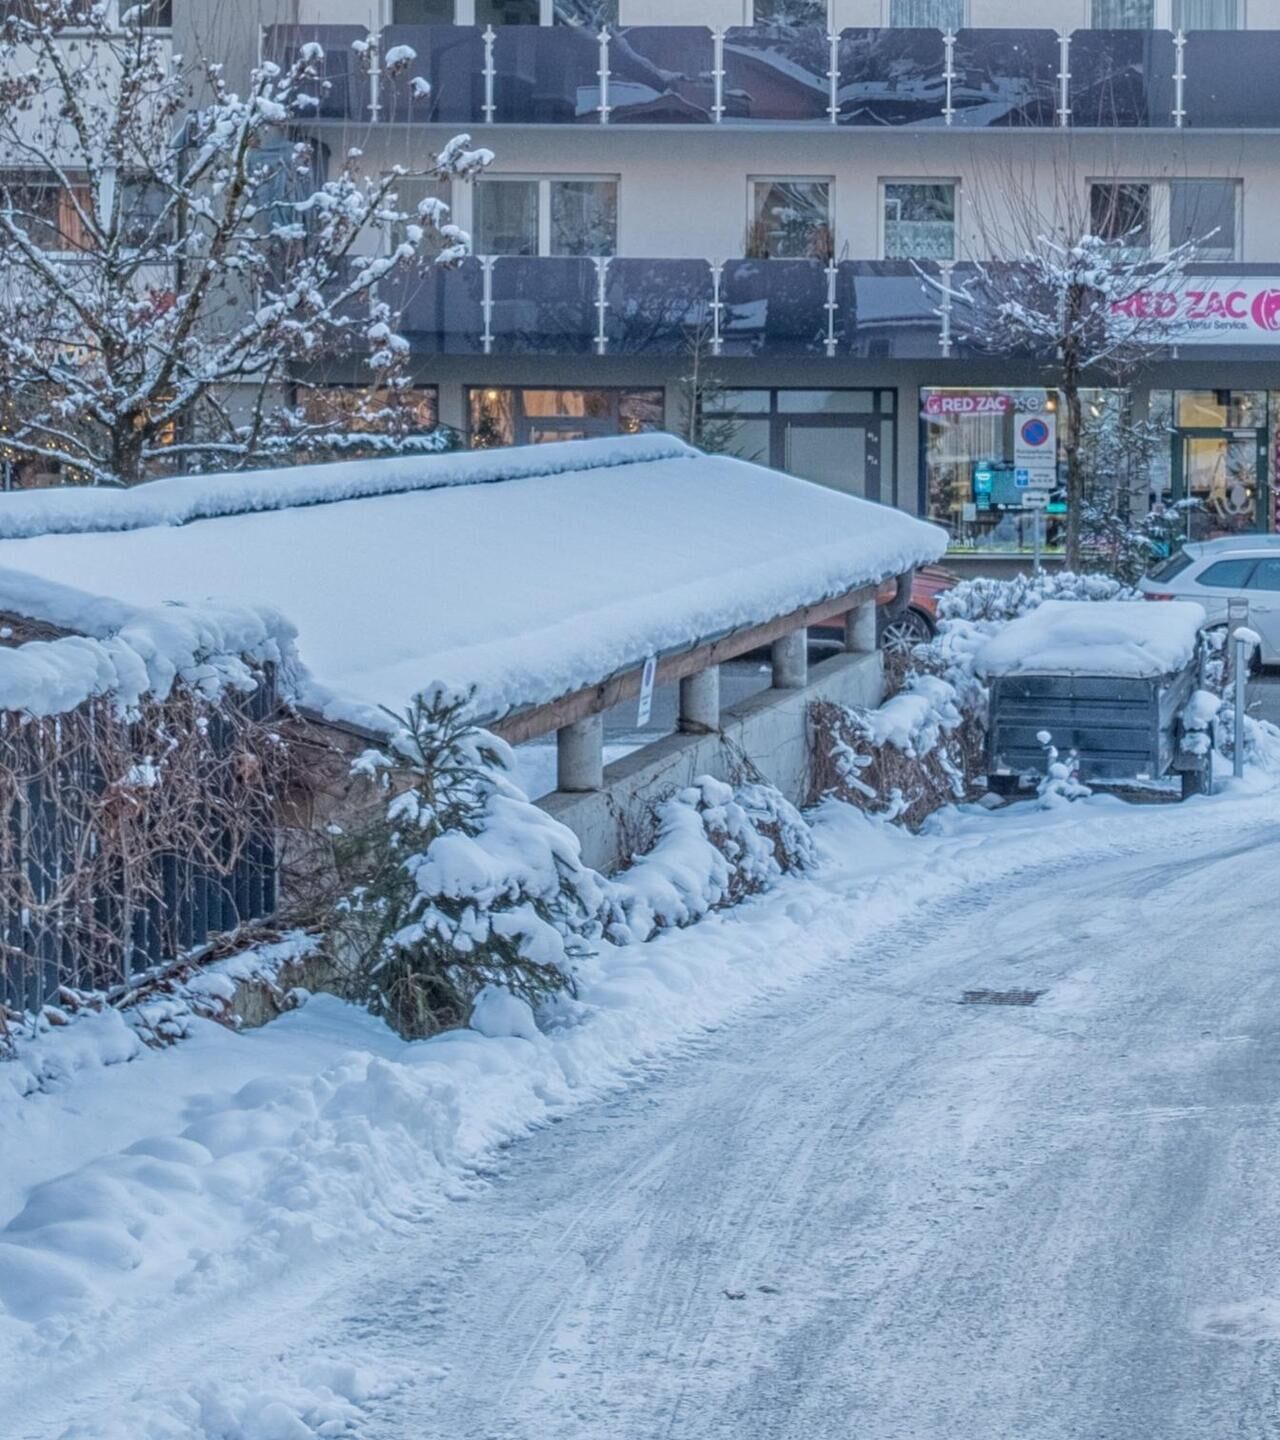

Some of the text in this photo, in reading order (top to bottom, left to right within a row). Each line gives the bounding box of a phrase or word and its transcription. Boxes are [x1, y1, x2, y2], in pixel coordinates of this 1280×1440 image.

[1111, 291, 1248, 318] RED ZAC
[942, 396, 1006, 411] RED ZAC
